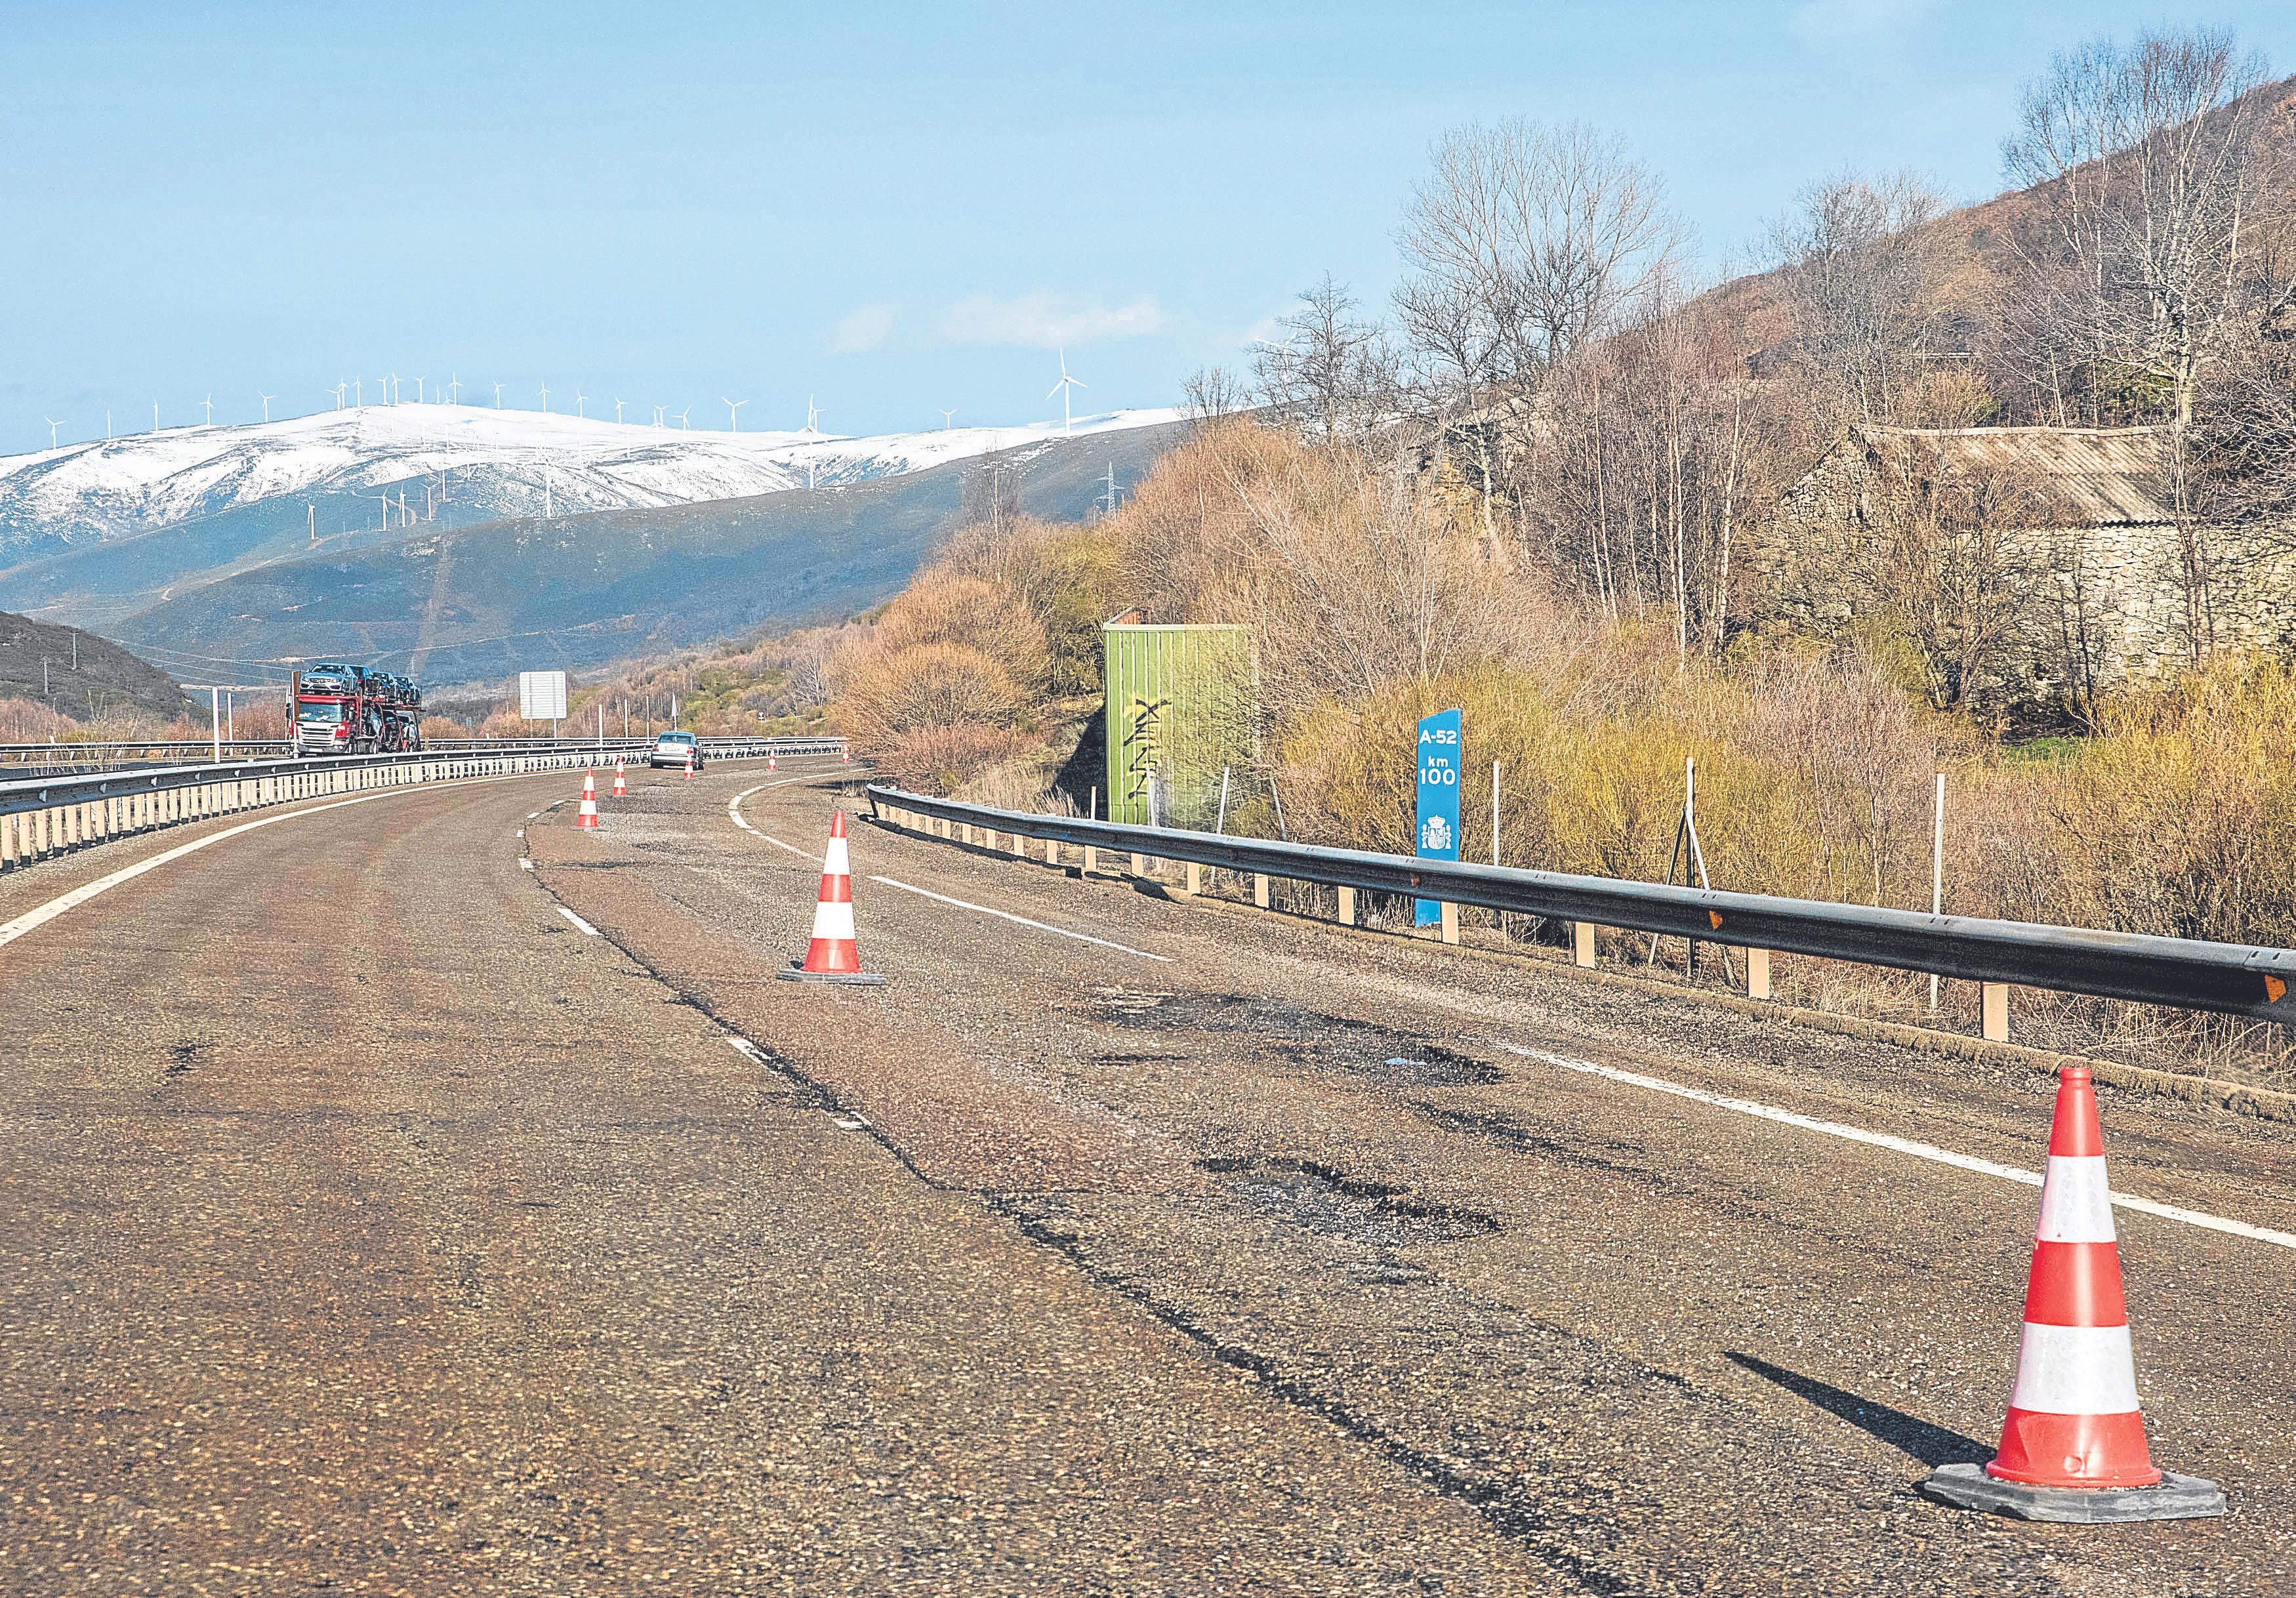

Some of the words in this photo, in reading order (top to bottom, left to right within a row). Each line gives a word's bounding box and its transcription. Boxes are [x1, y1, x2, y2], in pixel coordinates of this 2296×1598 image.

[1419, 729, 1457, 745] A-52
[1427, 755, 1448, 768] km
[1420, 768, 1456, 785] 100
